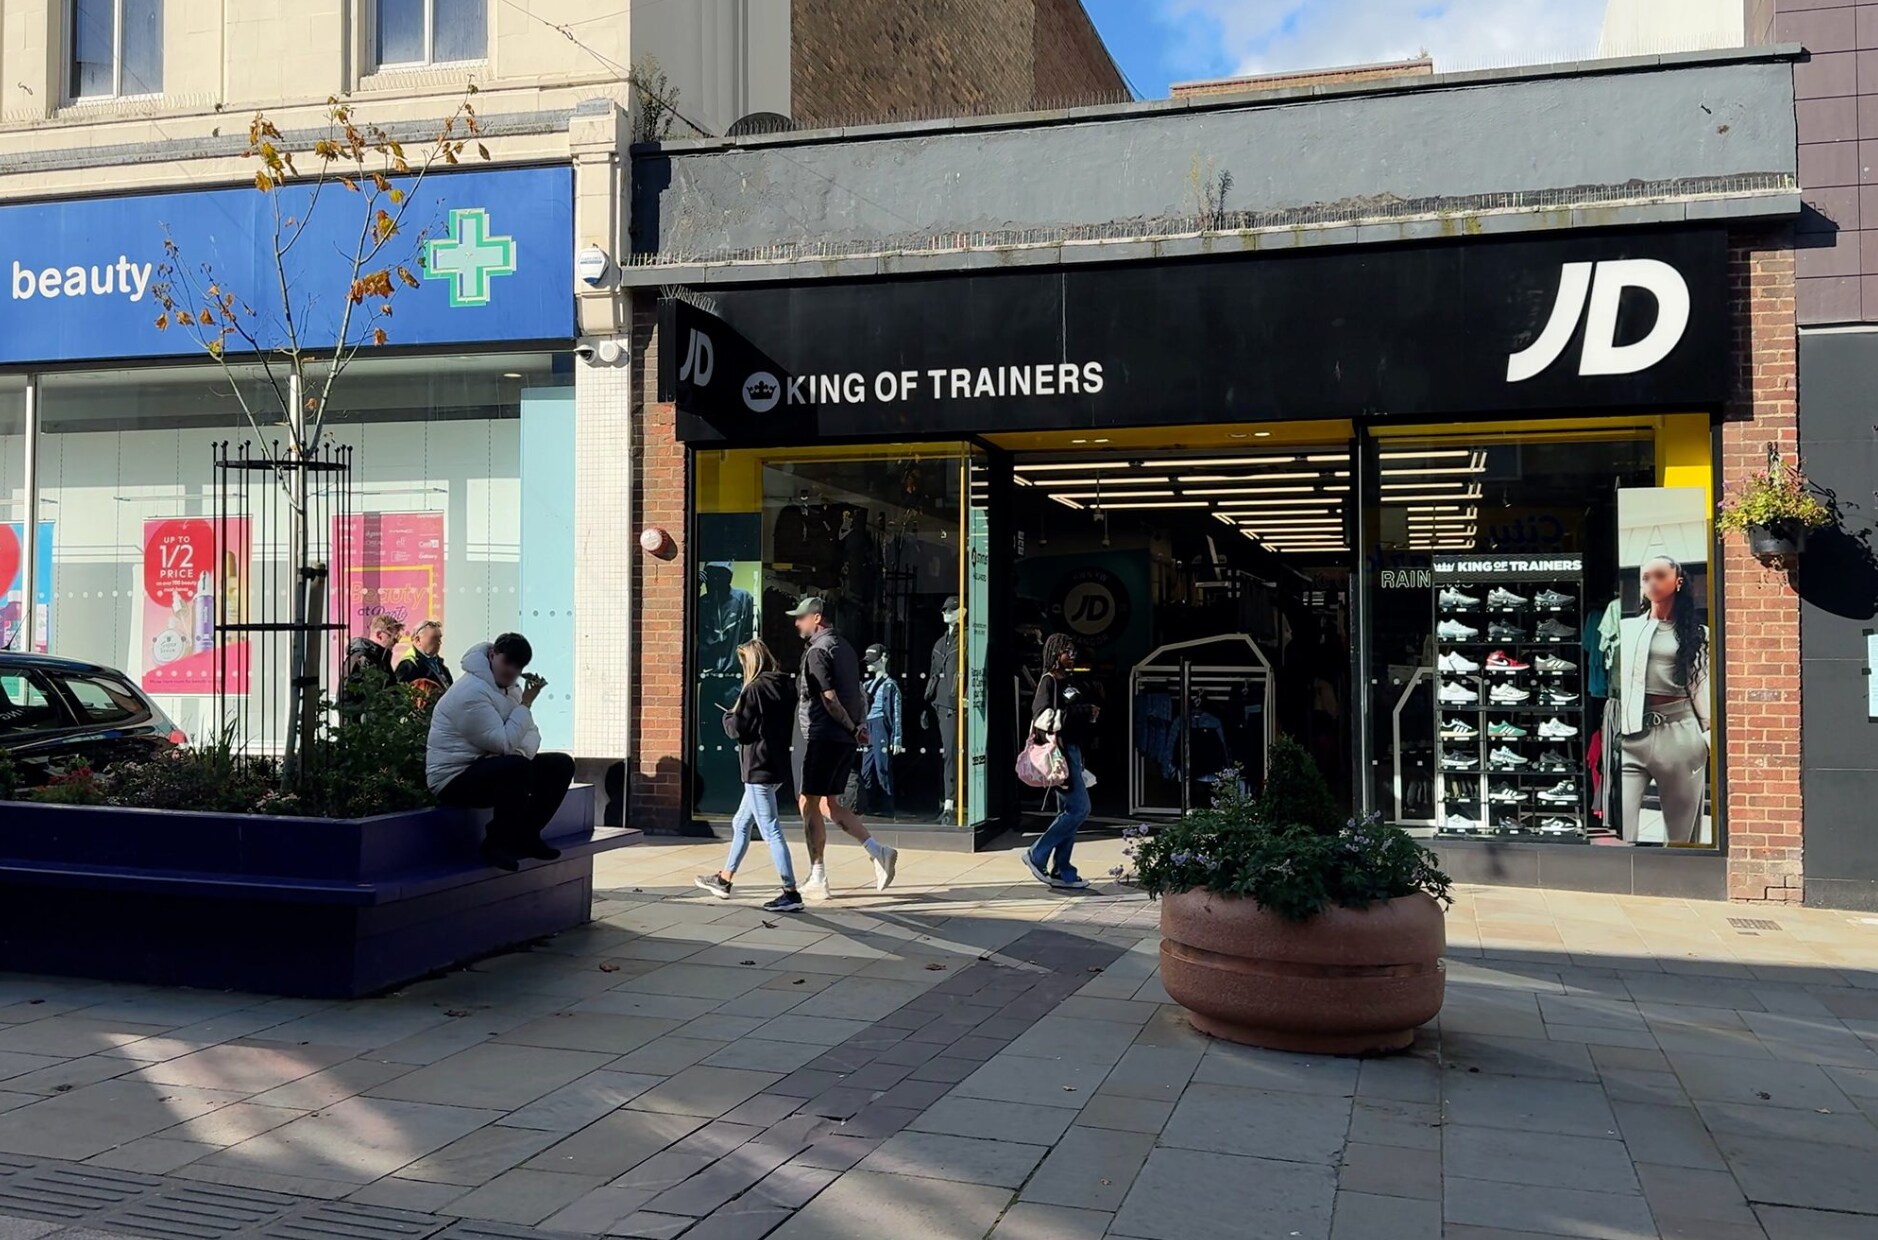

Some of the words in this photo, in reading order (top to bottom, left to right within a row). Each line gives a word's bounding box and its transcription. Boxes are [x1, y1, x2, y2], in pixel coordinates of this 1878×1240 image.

[11, 255, 152, 302] beauty
[1506, 258, 1690, 382] JD
[680, 328, 714, 387] JD
[787, 372, 866, 405] KING
[874, 370, 918, 403] OF
[927, 361, 1104, 400] TRAINERS
[159, 544, 194, 568] 1/2
[1458, 561, 1492, 572] KING
[1493, 561, 1508, 571] OF
[1511, 560, 1583, 572] TRAINERS
[160, 569, 194, 578] PRICE
[352, 582, 425, 609] Beauty
[1071, 594, 1110, 622] JD
[358, 606, 369, 617] at
